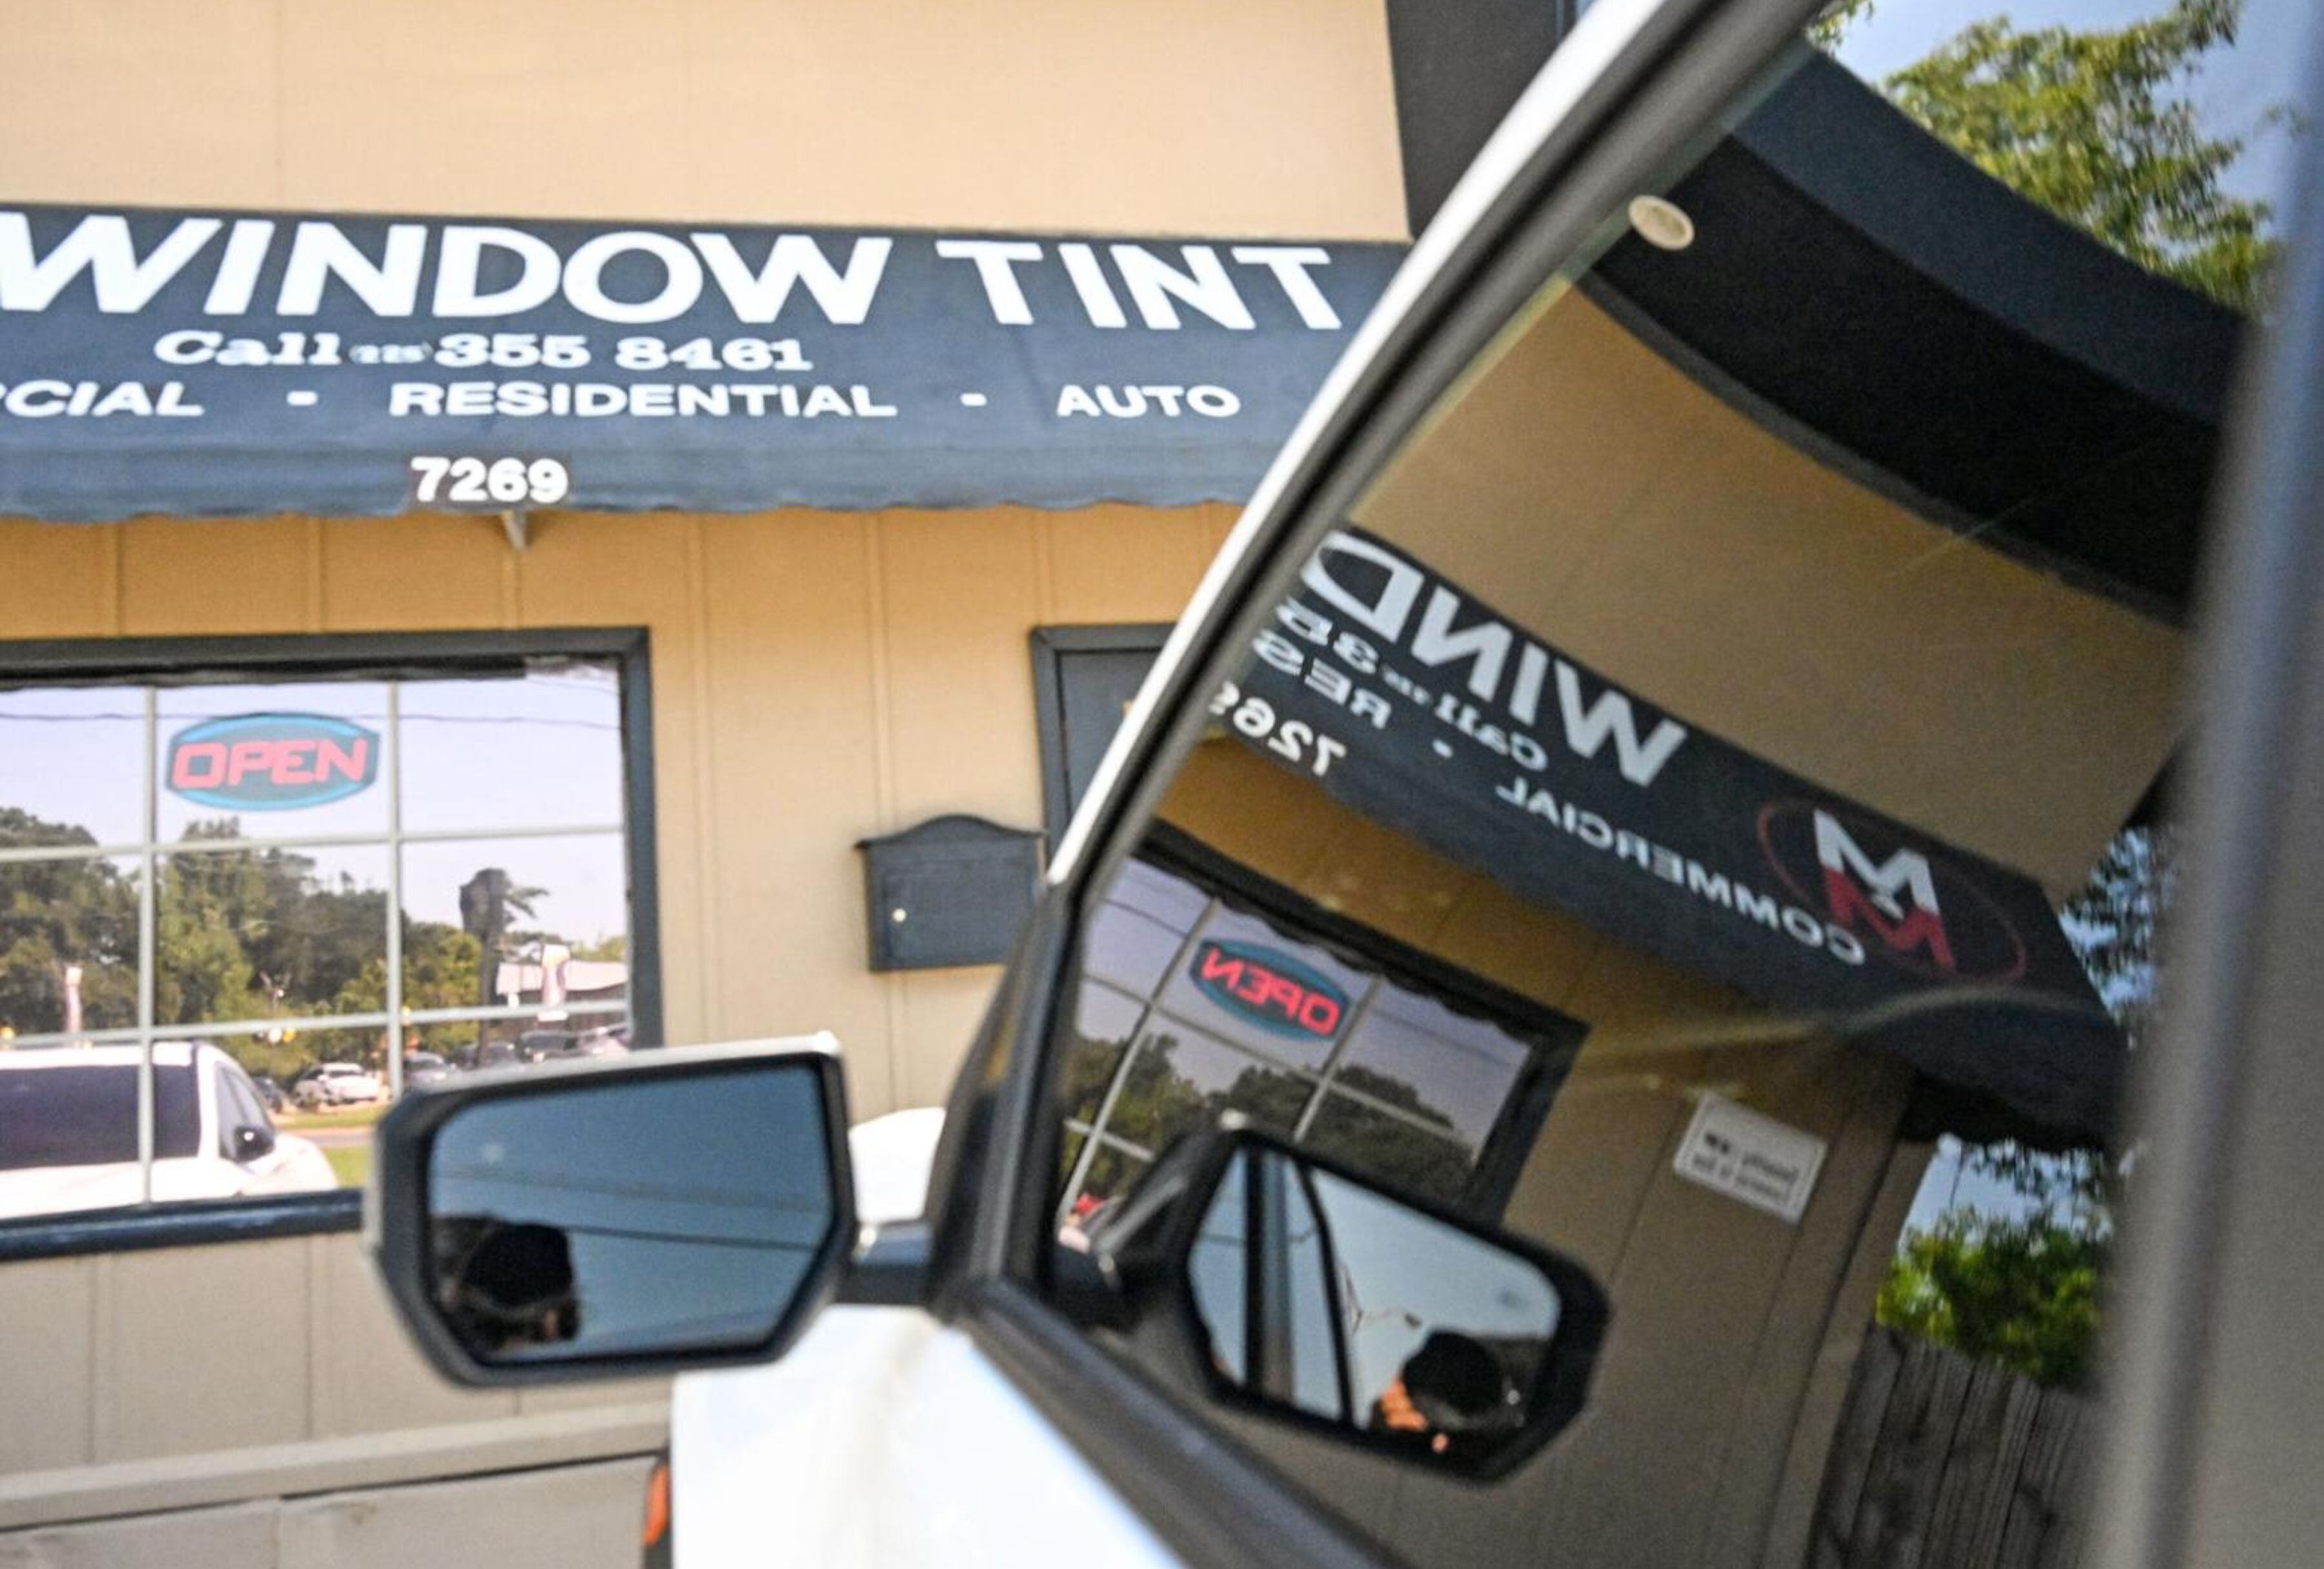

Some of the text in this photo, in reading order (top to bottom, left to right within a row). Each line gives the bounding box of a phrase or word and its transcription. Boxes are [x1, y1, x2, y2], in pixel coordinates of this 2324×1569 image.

[0, 211, 1341, 330] WINDOW TINT
[154, 330, 341, 365] Call
[433, 333, 591, 368] 355
[614, 336, 813, 371] 8461
[0, 380, 205, 417] CIAL
[389, 382, 898, 418] RESIDENTIAL
[1055, 384, 1241, 418] AUTO
[410, 456, 569, 504] 7269
[172, 738, 367, 788] OPEN
